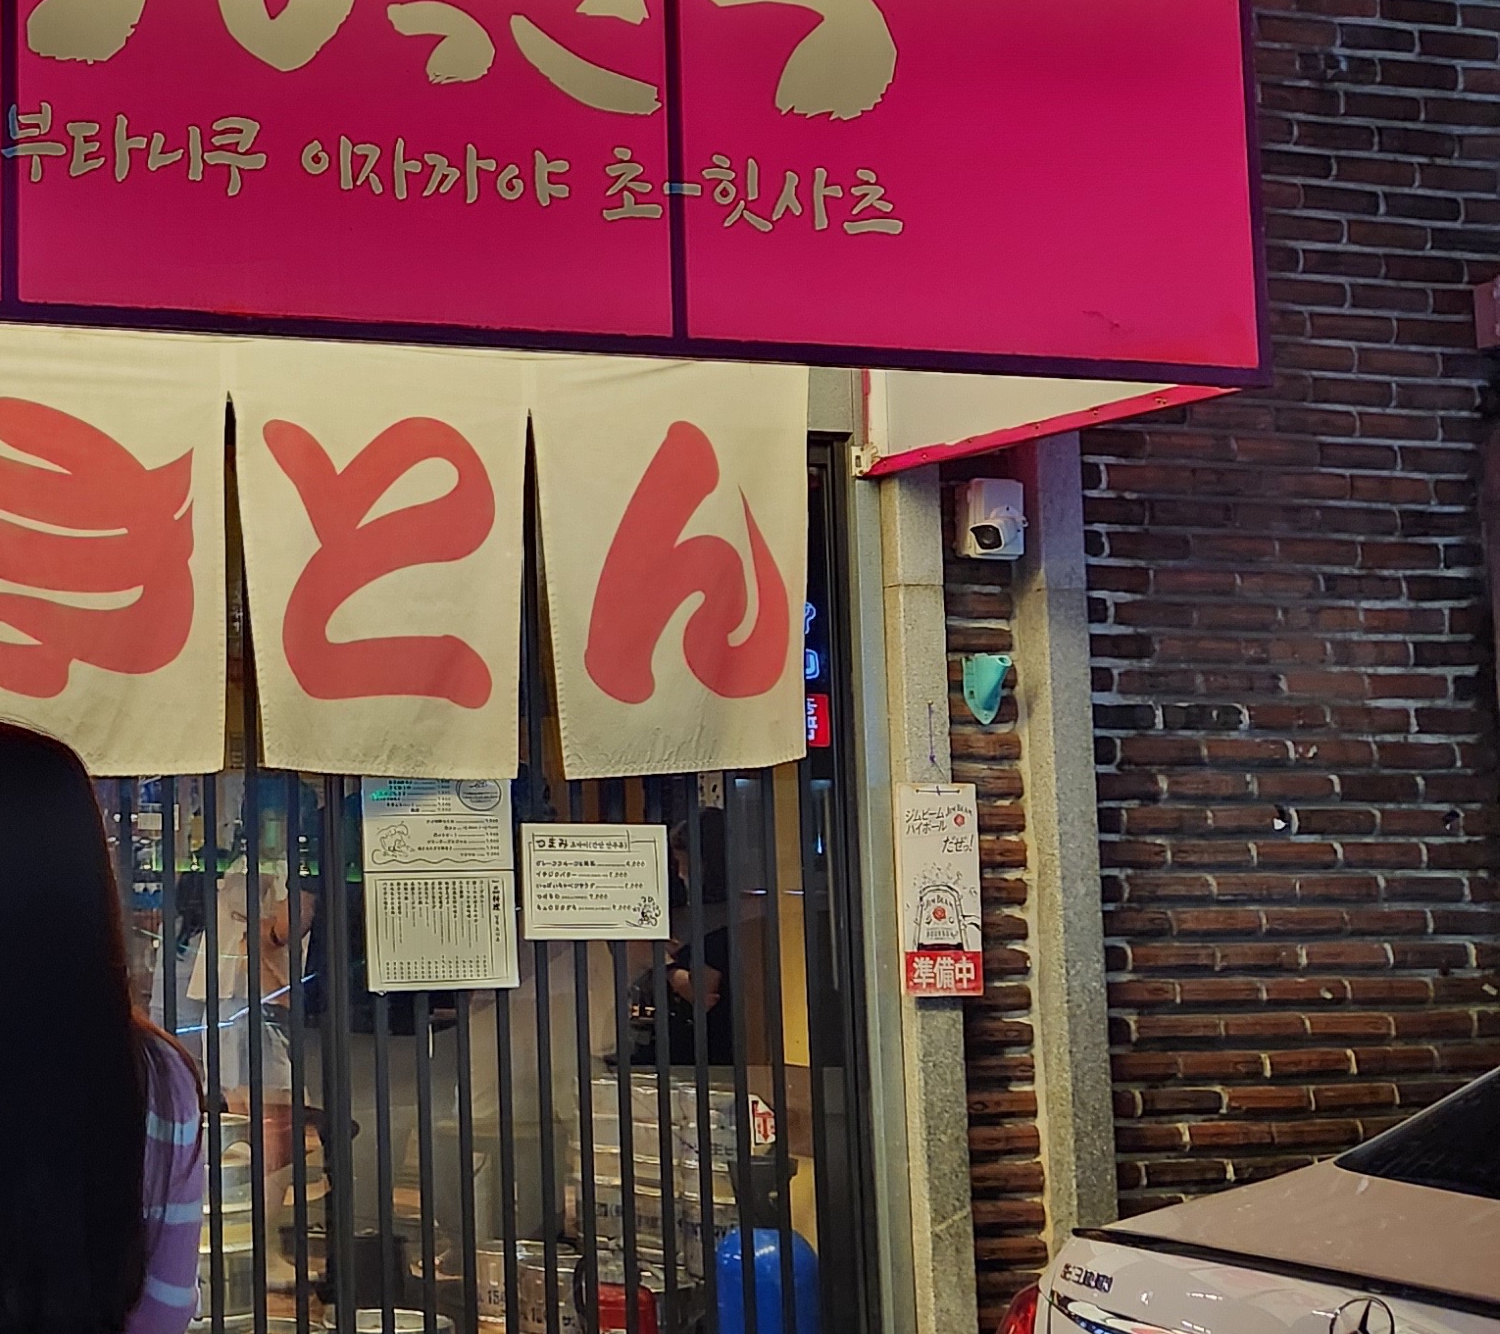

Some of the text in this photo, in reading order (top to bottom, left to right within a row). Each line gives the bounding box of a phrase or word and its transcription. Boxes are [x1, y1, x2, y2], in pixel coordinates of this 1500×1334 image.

[2, 101, 266, 195] 부타니쿠
[301, 138, 570, 207] 이자까야
[905, 807, 945, 824] ジムビーム
[905, 820, 947, 835] ハイボール
[536, 837, 568, 848] つまみ
[912, 955, 975, 989] 準備中
